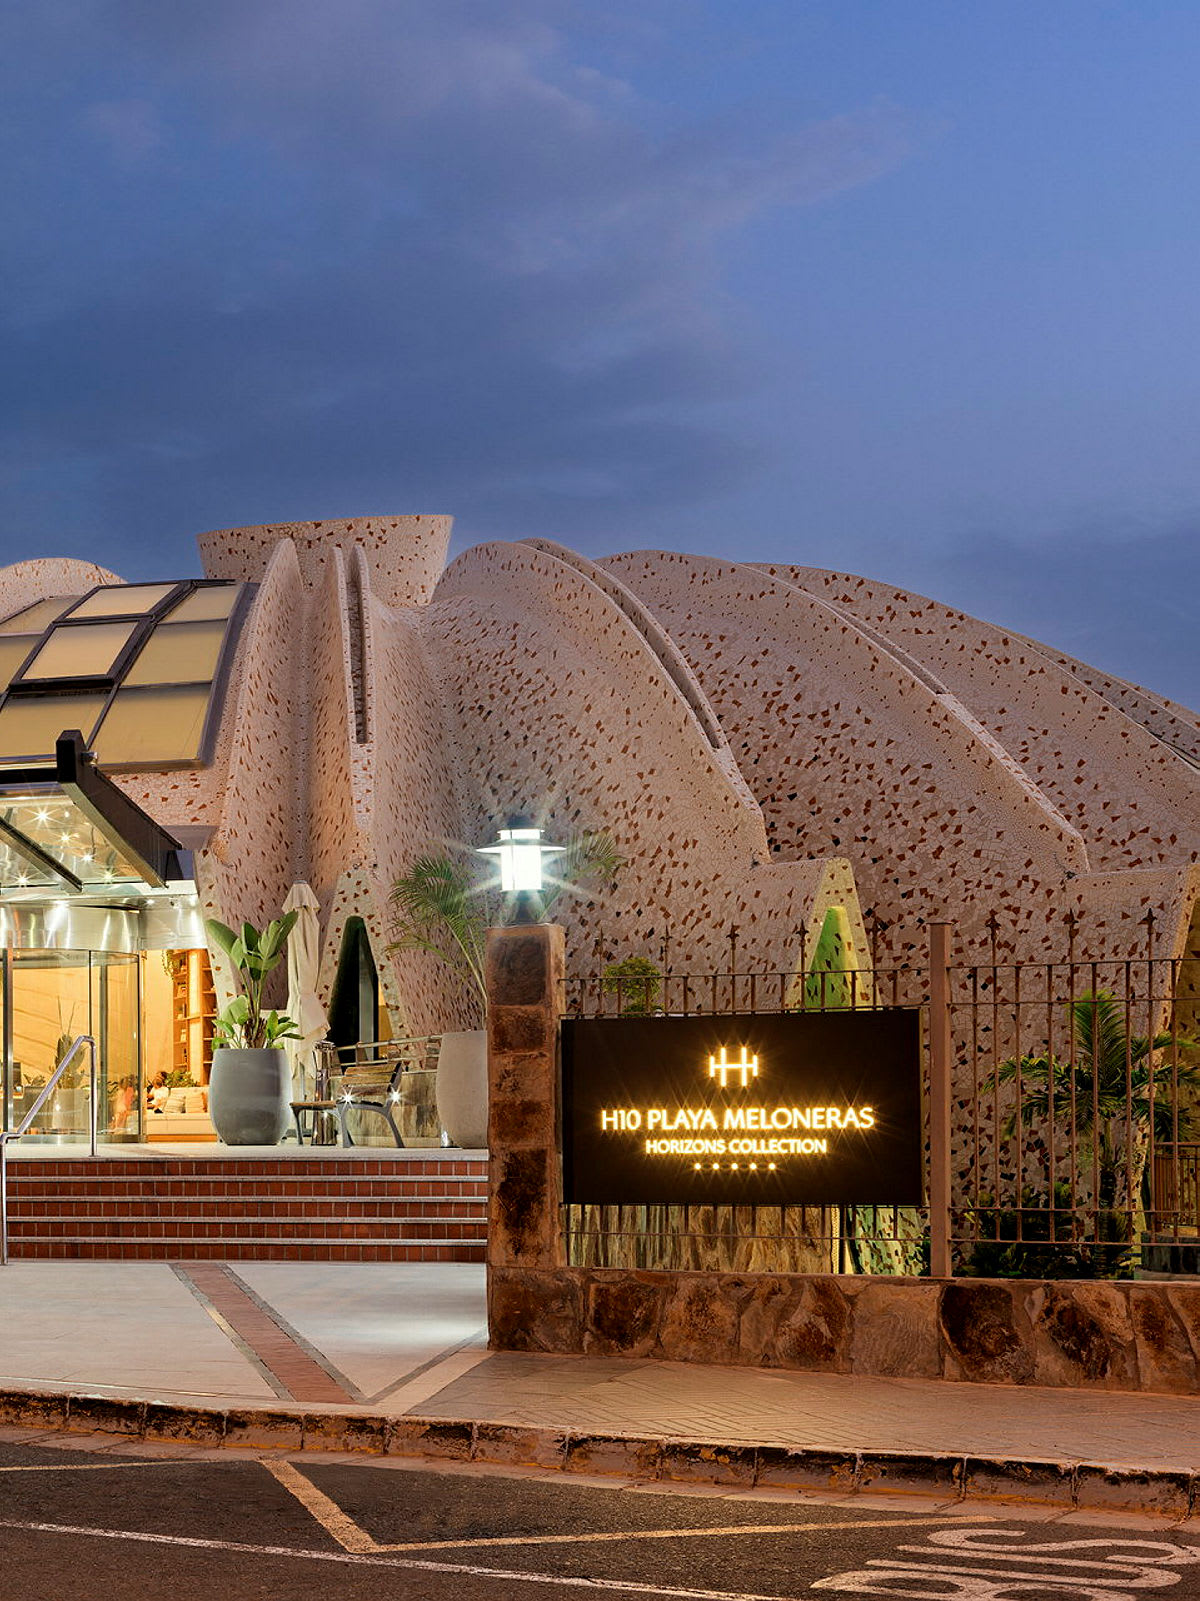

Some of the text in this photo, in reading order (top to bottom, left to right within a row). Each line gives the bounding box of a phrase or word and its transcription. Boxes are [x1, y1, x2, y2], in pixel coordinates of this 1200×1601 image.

[601, 1106, 876, 1131] H10 PLAYA MELONERAS
[645, 1137, 827, 1155] HORIZONS COLLECTION
